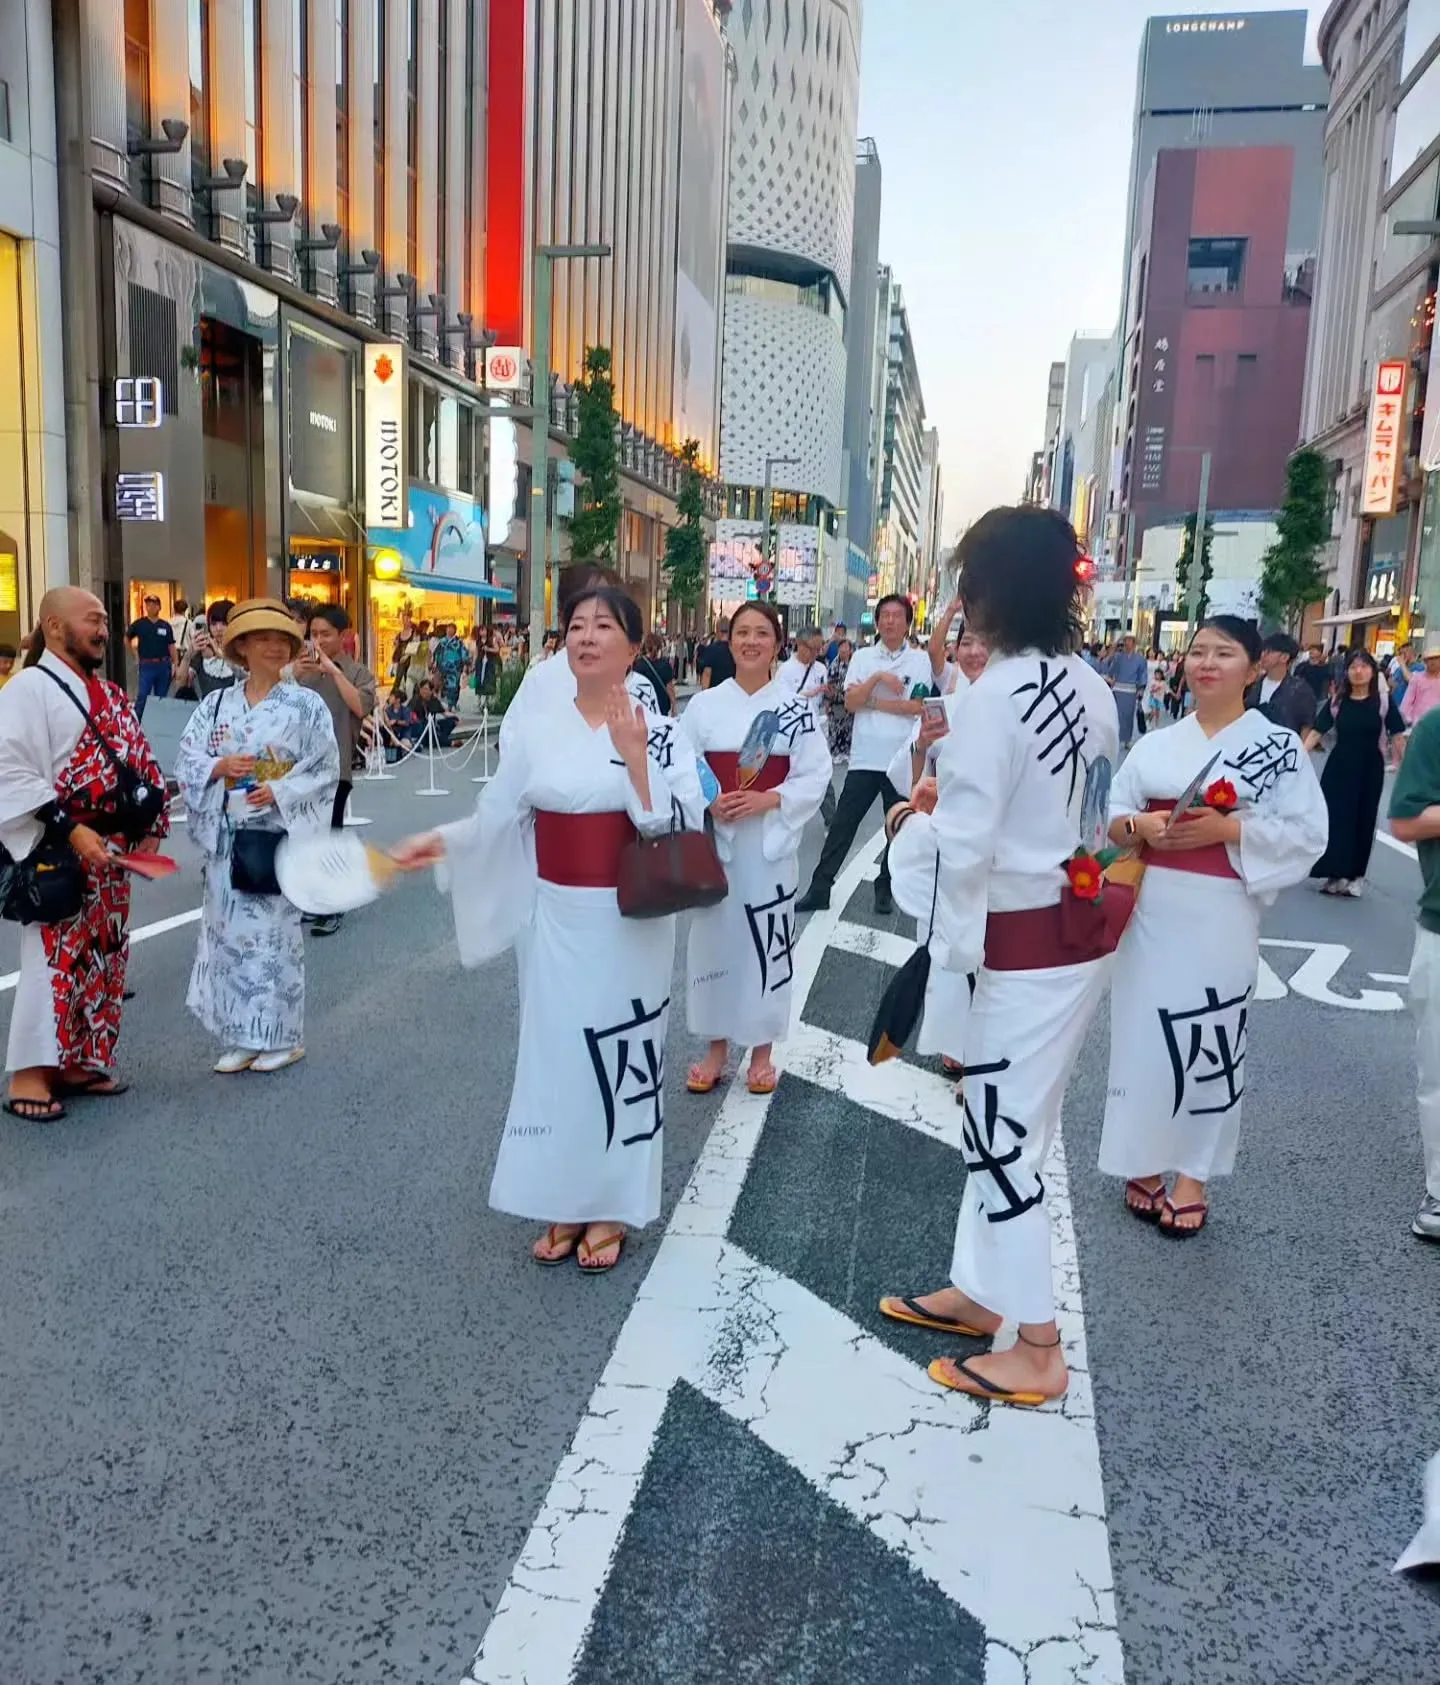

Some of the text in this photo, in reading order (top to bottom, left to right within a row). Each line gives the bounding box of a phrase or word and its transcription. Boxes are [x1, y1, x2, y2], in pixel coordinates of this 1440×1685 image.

[1166, 19, 1245, 33] LONGCHAMP
[1223, 732, 1298, 803] 銀
[743, 884, 799, 998] 座
[583, 997, 670, 1152] 座
[1157, 985, 1252, 1119] 座
